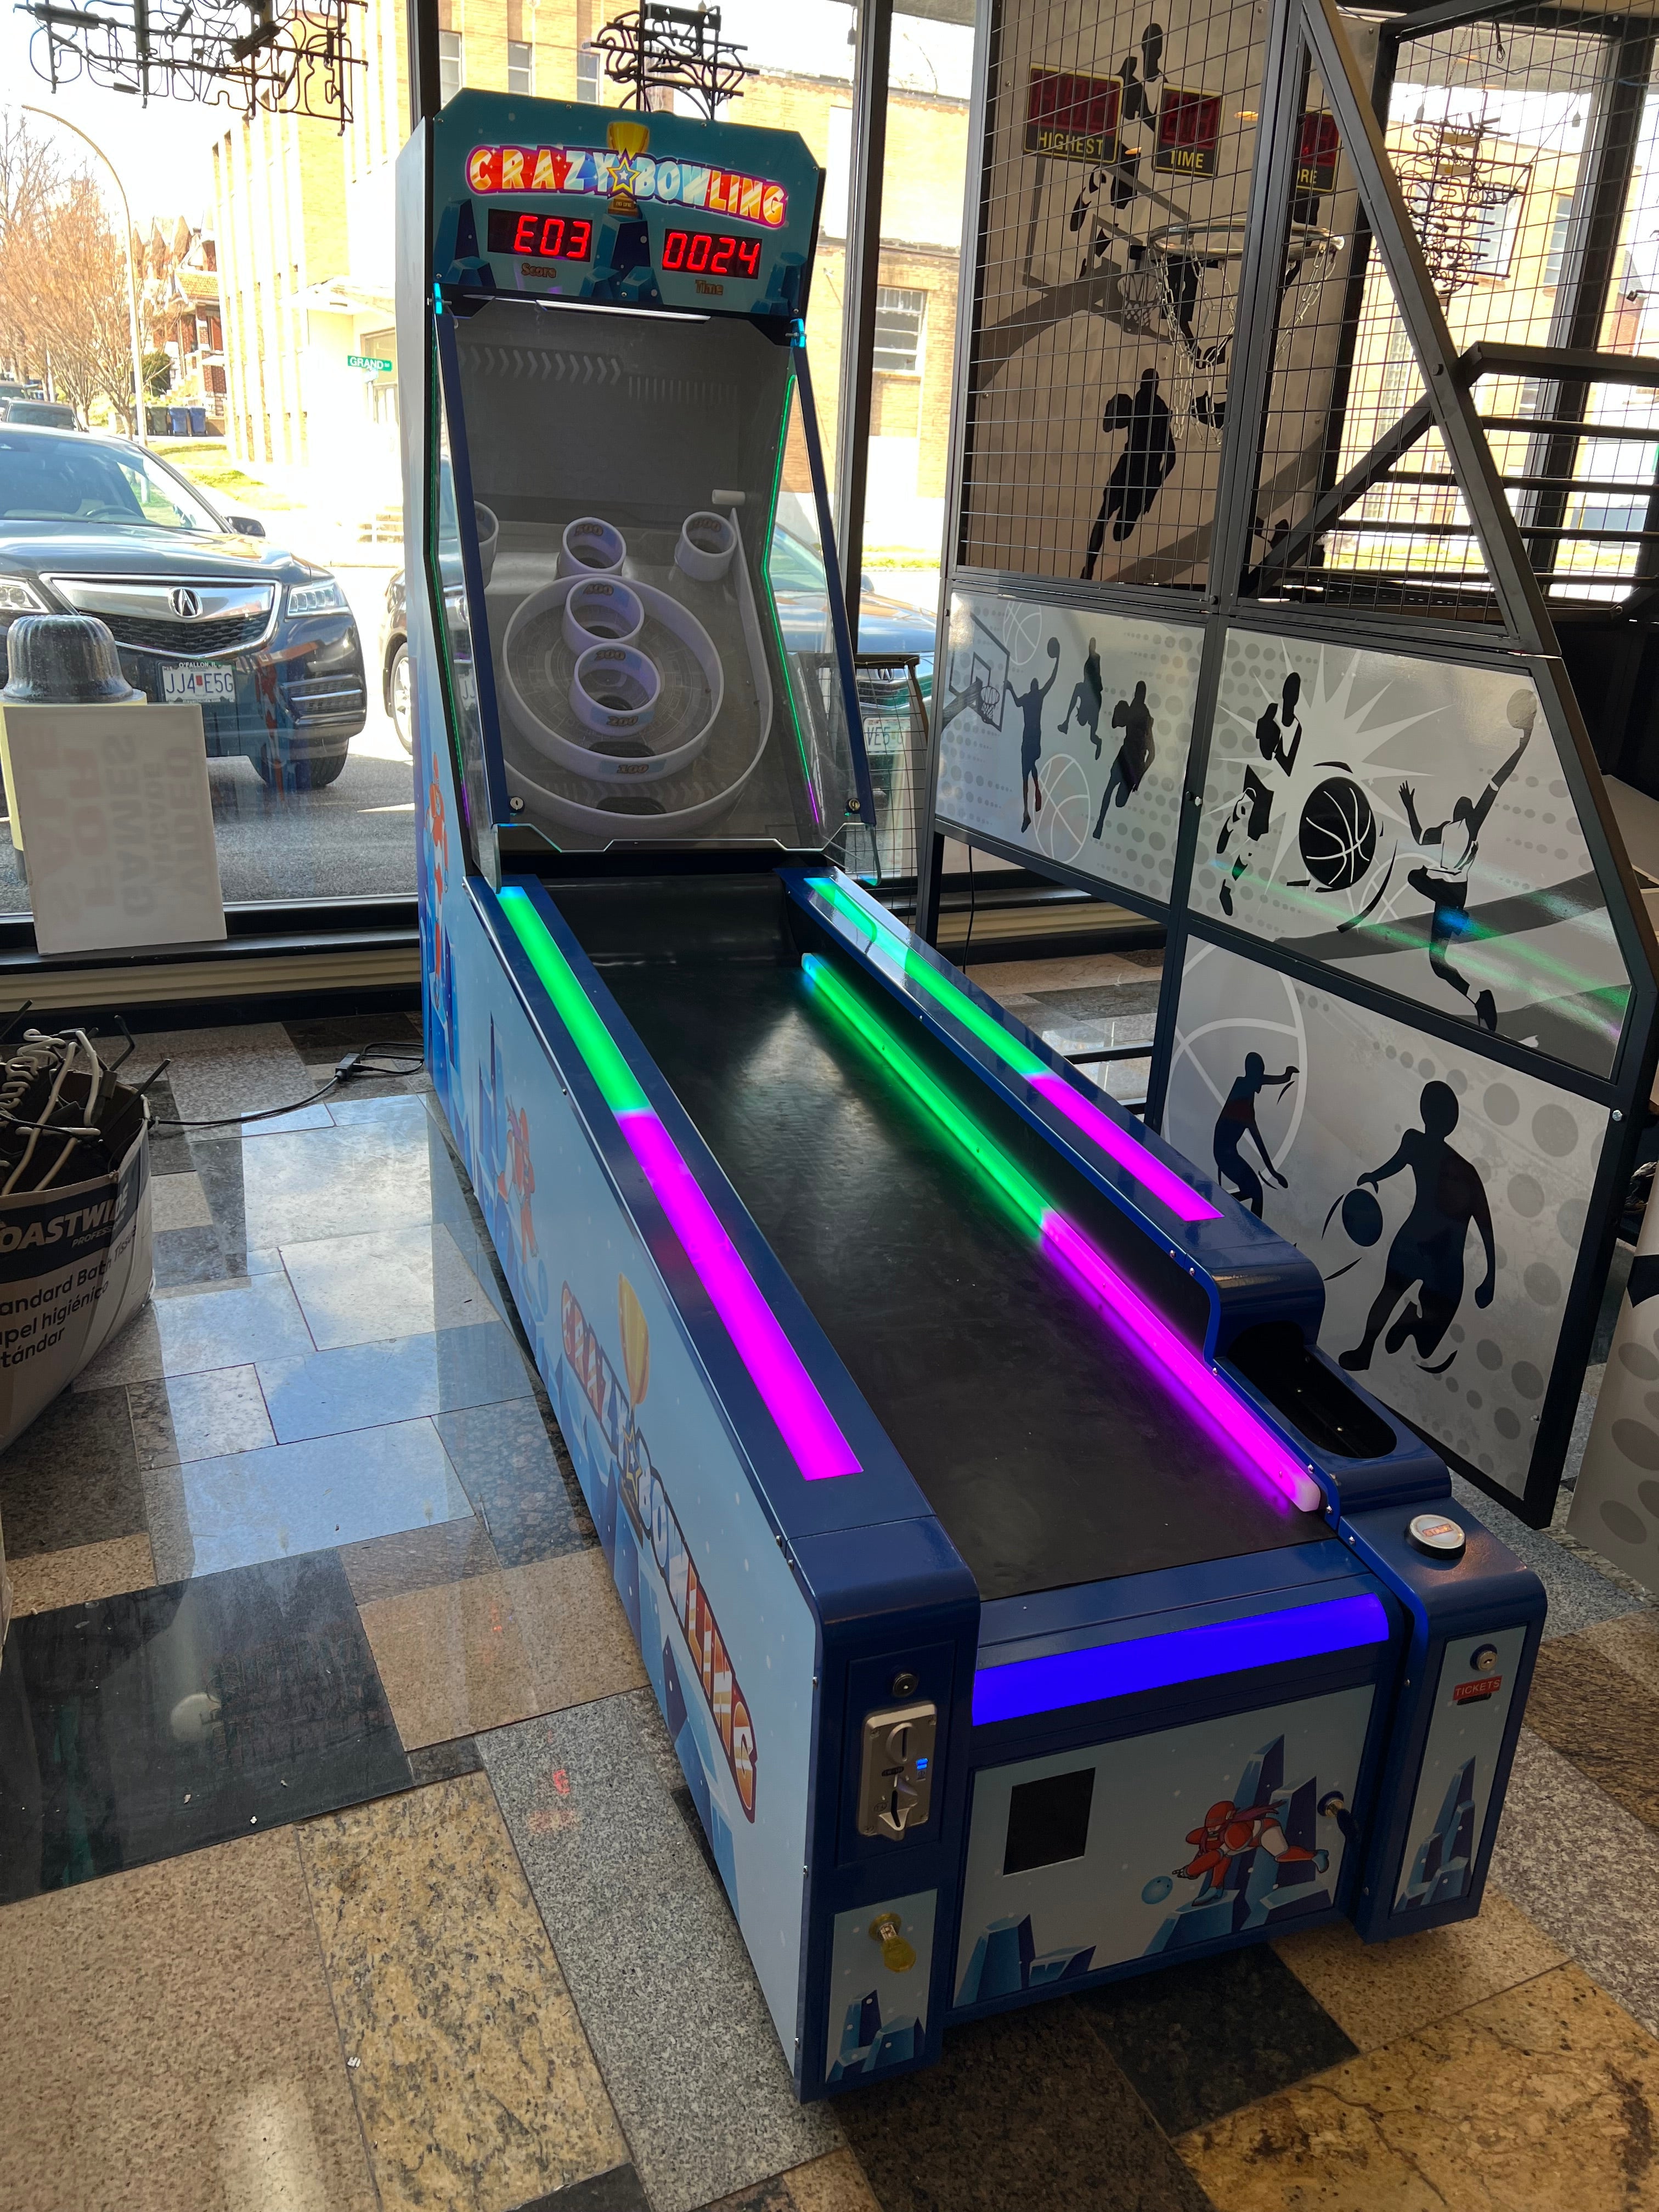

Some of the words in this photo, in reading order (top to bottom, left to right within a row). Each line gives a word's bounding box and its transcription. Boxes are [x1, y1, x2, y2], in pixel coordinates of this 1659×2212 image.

[1039, 131, 1103, 156] HIGHEST
[1170, 150, 1204, 169] TIME
[470, 149, 617, 192] CRAZY
[634, 156, 785, 224] BOWLING
[514, 215, 591, 258] E03
[662, 232, 760, 274] 0024
[522, 262, 556, 278] Score
[695, 279, 724, 295] Time
[349, 357, 384, 369] GRAND
[166, 673, 195, 693] JJ4
[204, 673, 234, 693] E5G
[606, 715, 639, 727] 200
[617, 764, 649, 774] 100
[0, 1182, 128, 1253] OASTWIDE
[77, 1258, 112, 1286] Bath
[42, 1280, 109, 1329] higiénico
[563, 1288, 629, 1469] CRAZY
[638, 1437, 753, 1810] BOWLING
[1455, 1679, 1500, 1696] TICKETS
